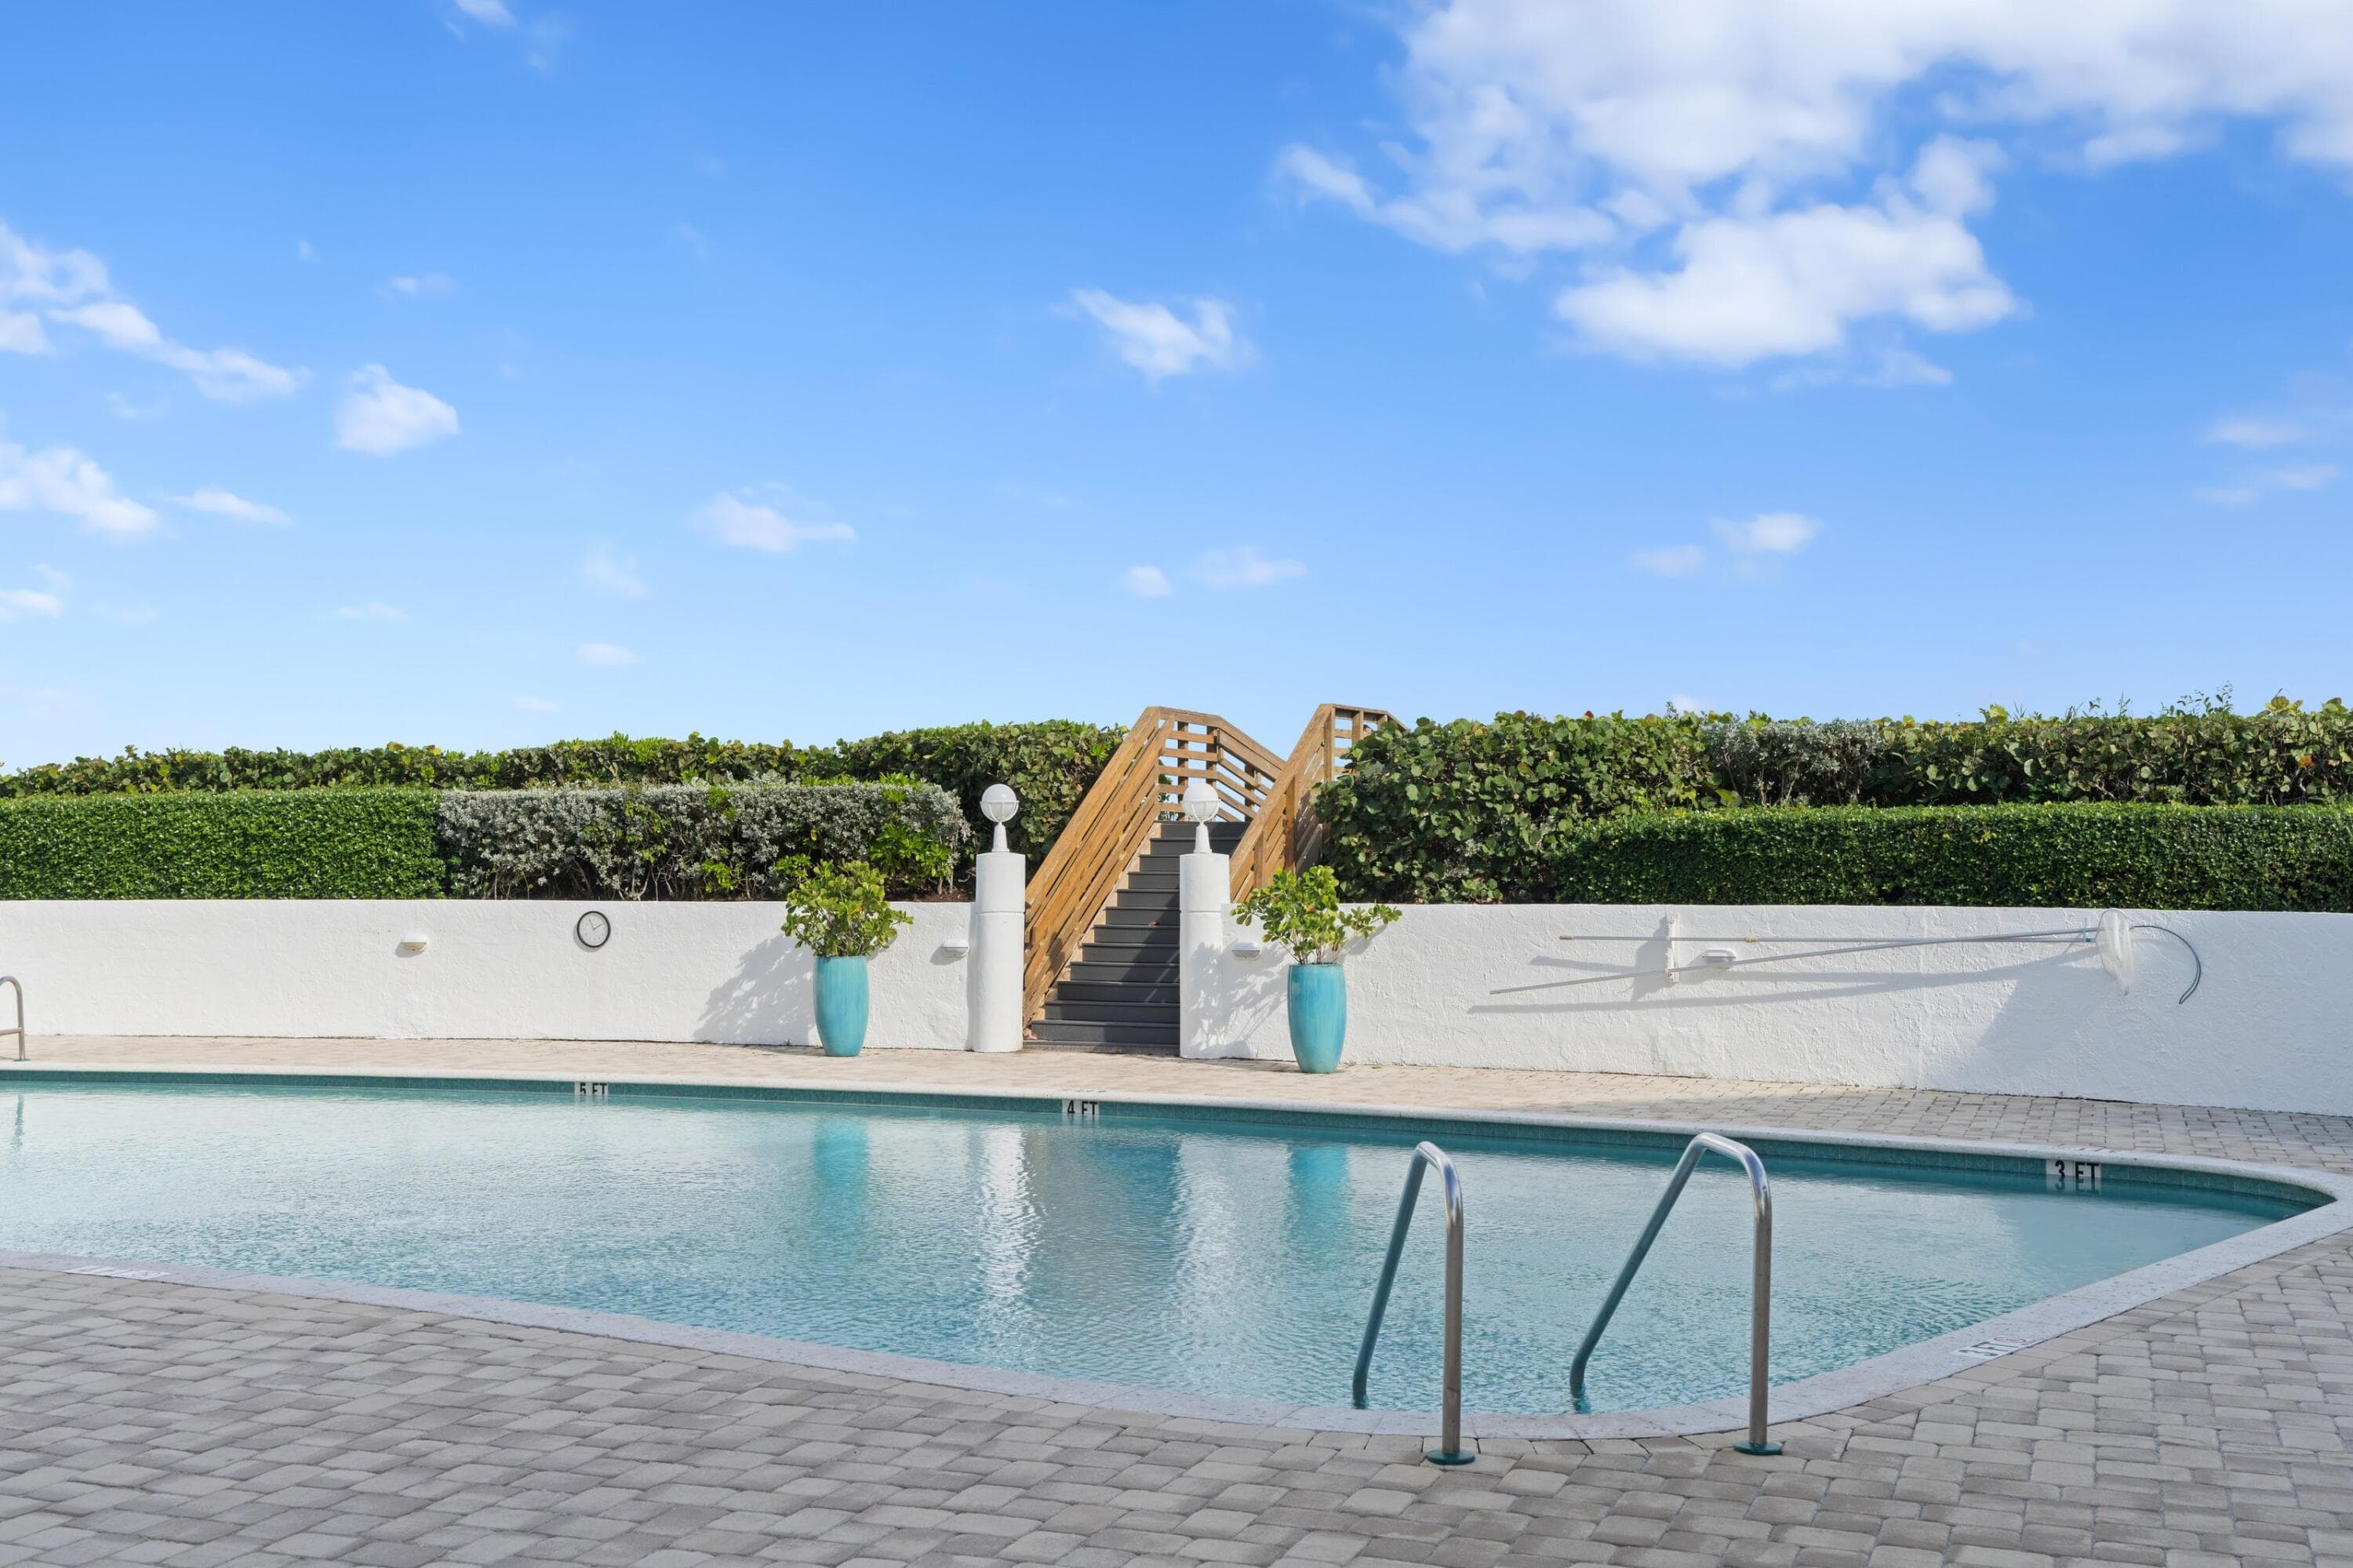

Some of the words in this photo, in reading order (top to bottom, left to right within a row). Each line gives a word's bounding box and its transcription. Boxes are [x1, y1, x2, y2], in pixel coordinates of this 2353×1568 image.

[592, 1083, 607, 1094] FT
[1067, 1100, 1075, 1114] 4
[1082, 1101, 1098, 1115] FT
[2055, 1160, 2065, 1179] 3
[2075, 1162, 2100, 1179] FT
[1970, 1341, 2020, 1352] FT
